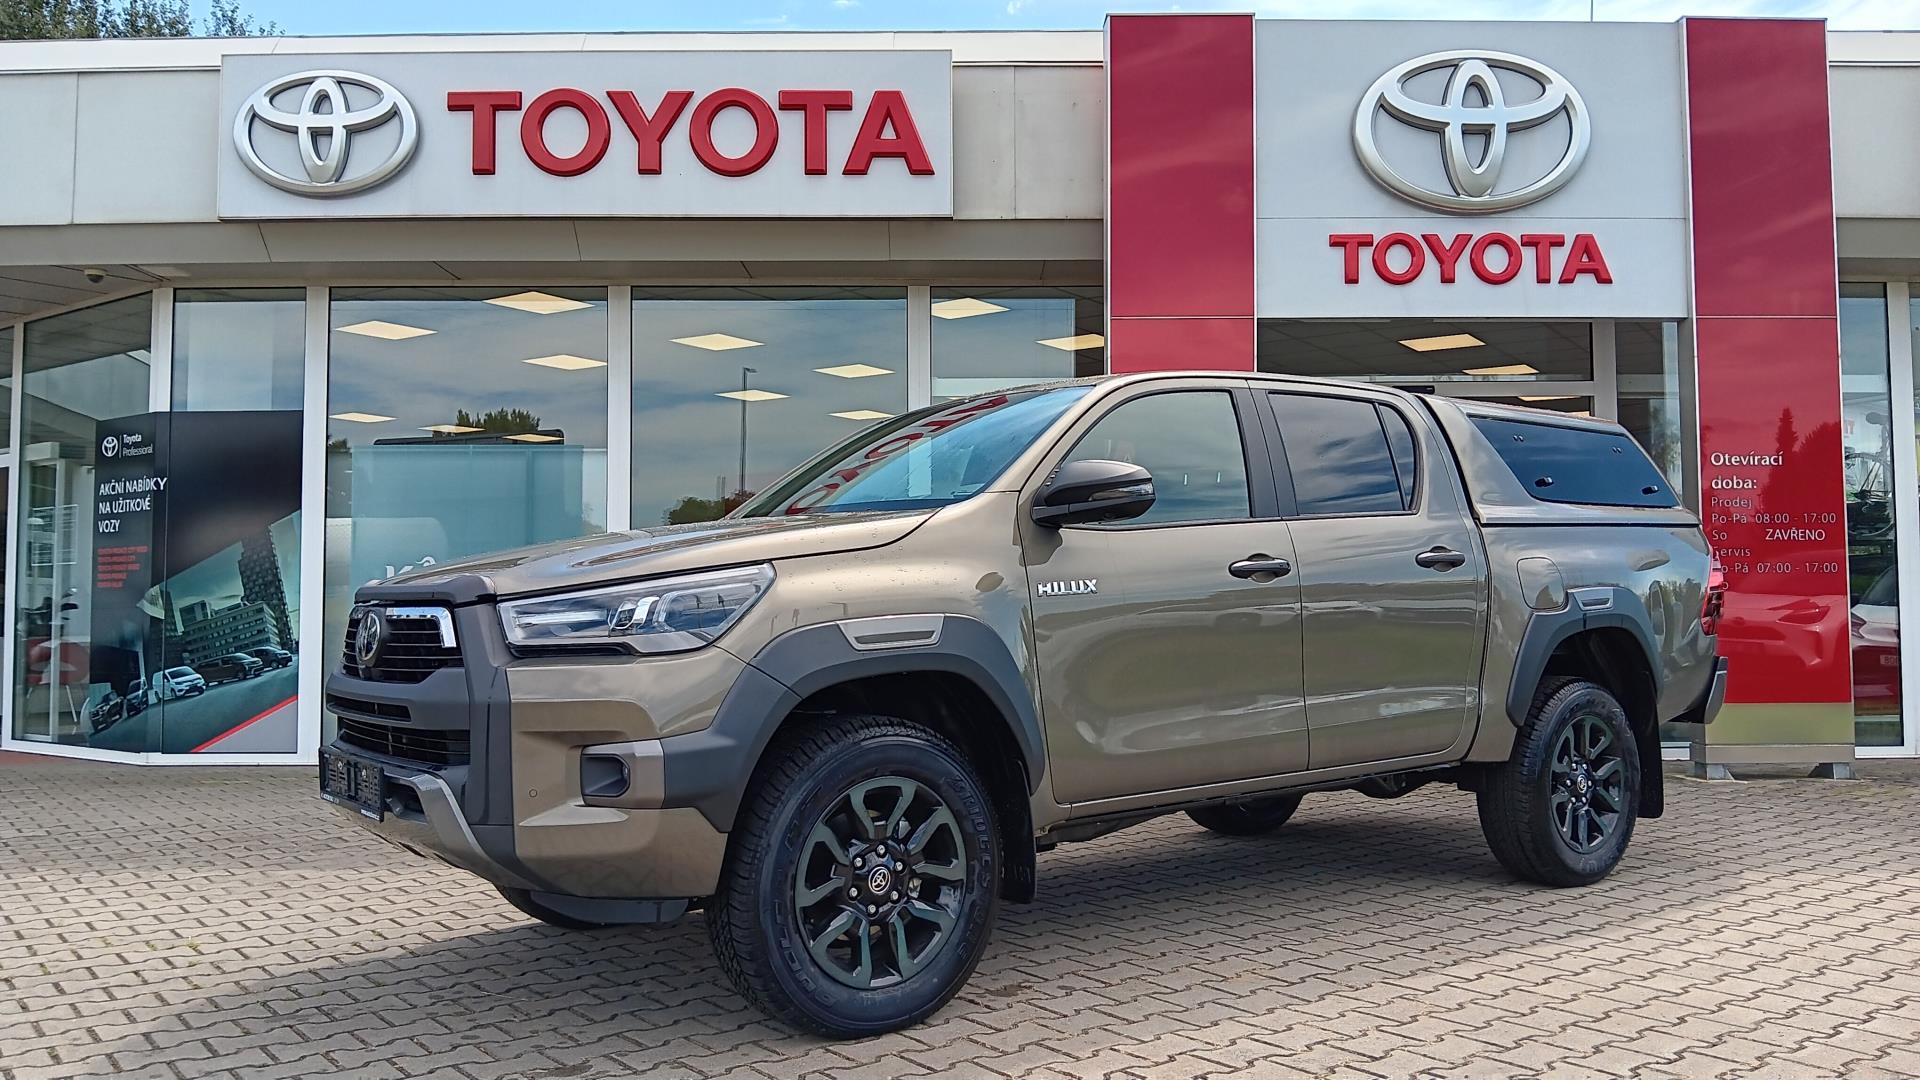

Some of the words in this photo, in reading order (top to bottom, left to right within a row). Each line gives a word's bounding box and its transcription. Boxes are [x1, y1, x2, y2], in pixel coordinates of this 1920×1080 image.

[447, 88, 935, 176] TOYOTA
[1329, 232, 1613, 285] TOYOTA
[123, 434, 142, 445] Toyota
[123, 444, 153, 456] Professional
[1711, 450, 1784, 466] Otevírací
[99, 478, 124, 495] AKČNÍ
[126, 475, 167, 492] NABÍDKY
[1711, 475, 1757, 489] doba:
[99, 502, 111, 514] NA
[113, 494, 151, 512] UŽITKOVÉ
[1711, 497, 1752, 509] Prodej
[1755, 512, 1790, 524] 08:00
[1803, 512, 1837, 524] 17:00
[98, 519, 120, 533] VOZY
[1712, 529, 1728, 541] So
[1765, 527, 1826, 541] ZAVŘENO
[1721, 562, 1749, 574] o-Pá
[1757, 562, 1791, 574] 07:00
[1805, 562, 1839, 574] 17:00
[1037, 579, 1097, 597] HILUX
